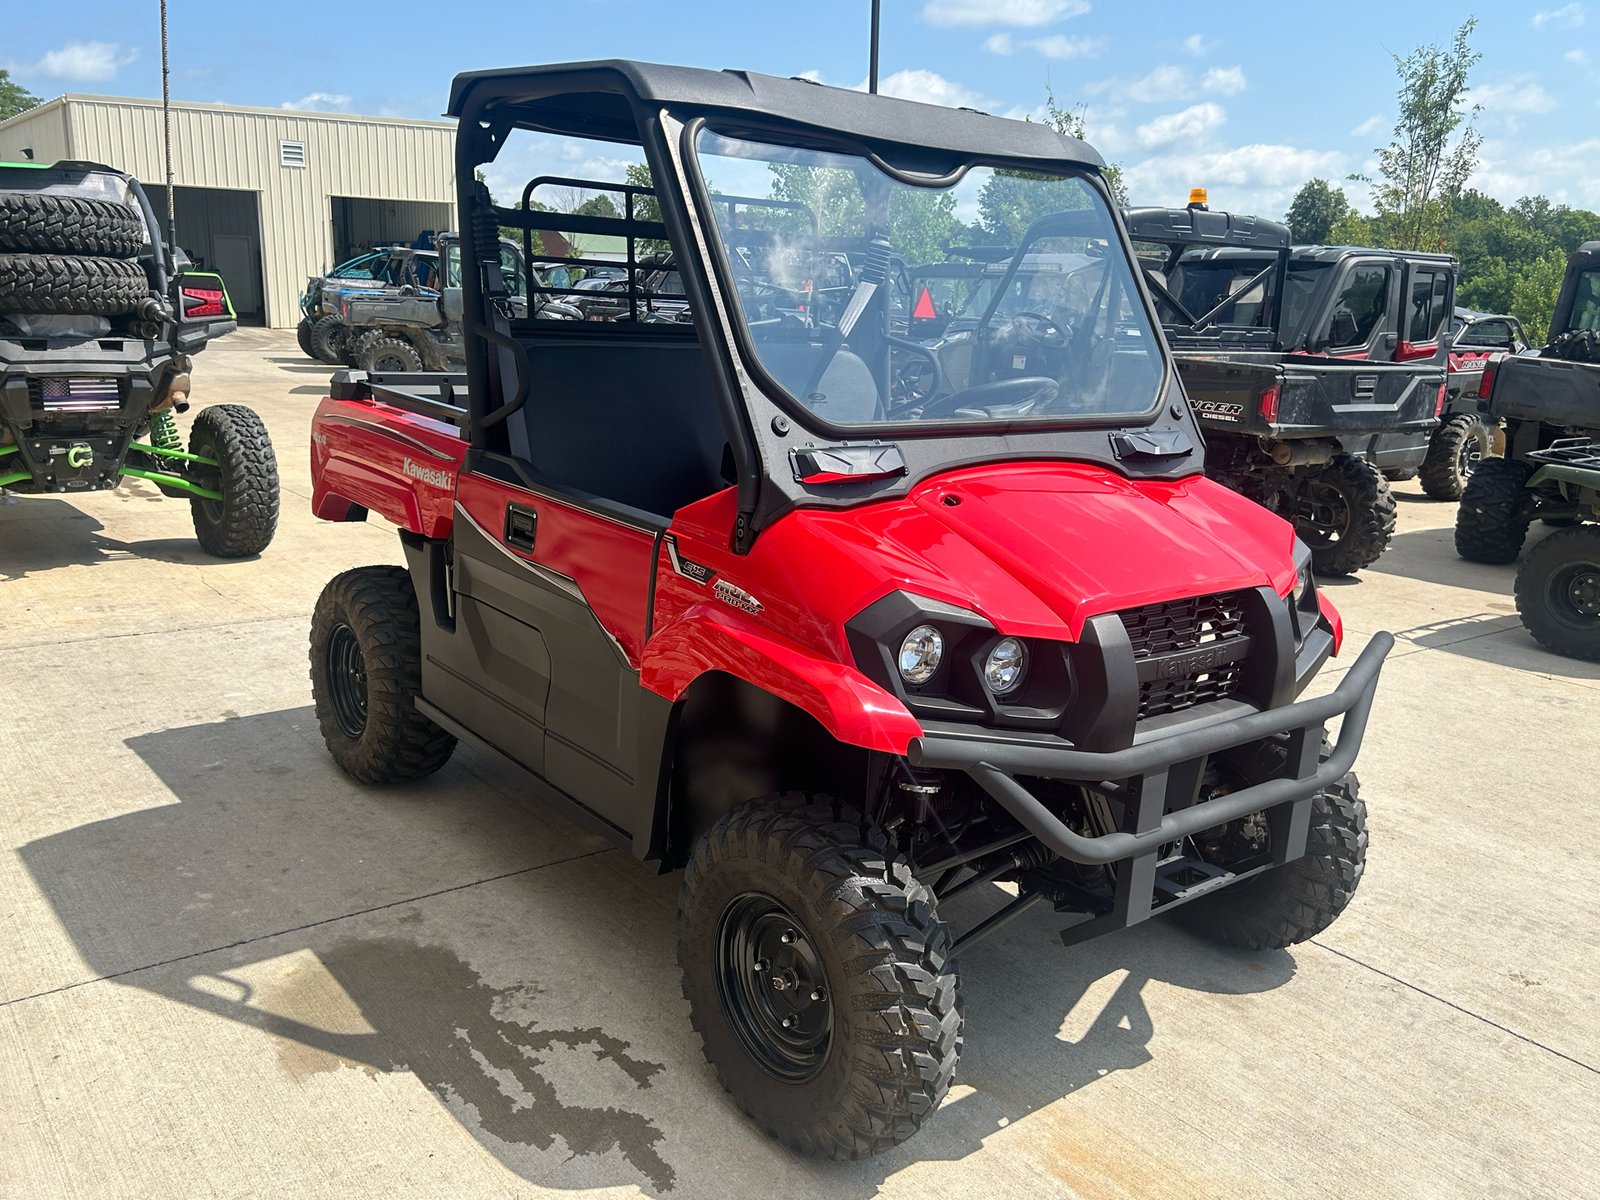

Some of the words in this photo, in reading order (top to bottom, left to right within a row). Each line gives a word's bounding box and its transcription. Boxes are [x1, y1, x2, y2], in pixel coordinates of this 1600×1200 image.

[1461, 360, 1487, 369] RANG
[1189, 399, 1244, 415] NGER
[1202, 412, 1239, 422] DIESEL
[403, 457, 452, 490] Kawasaki
[715, 591, 740, 608] PRO
[740, 603, 758, 616] MX
